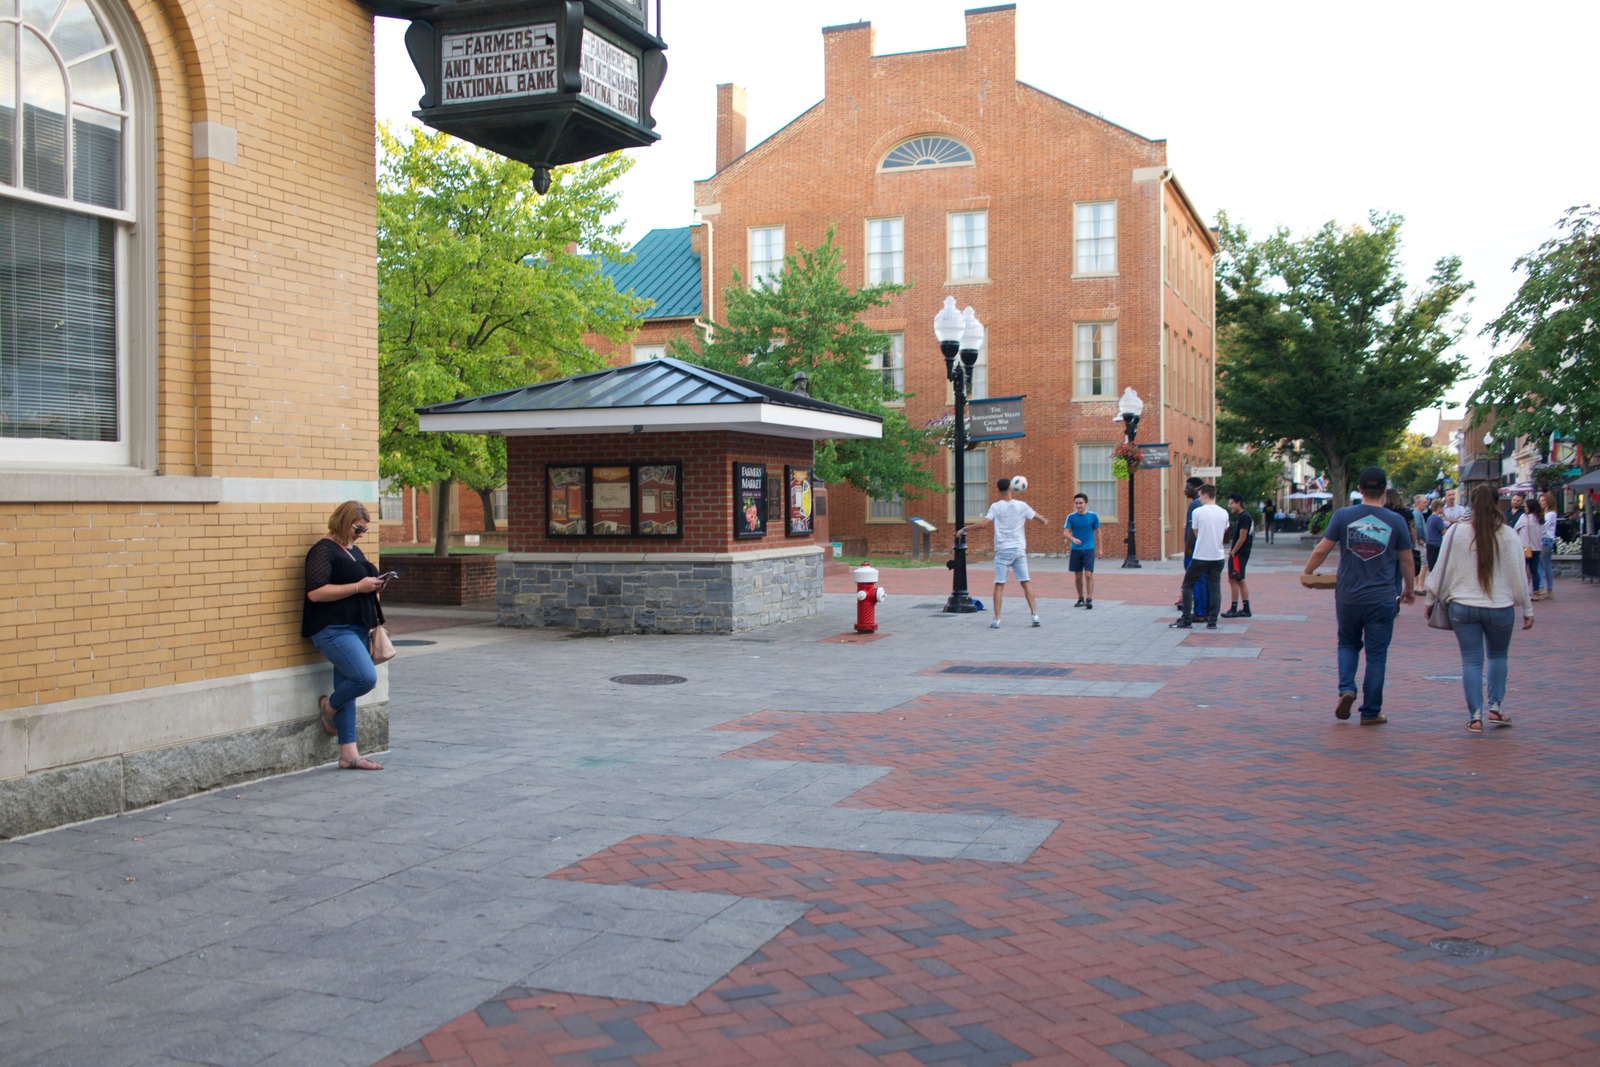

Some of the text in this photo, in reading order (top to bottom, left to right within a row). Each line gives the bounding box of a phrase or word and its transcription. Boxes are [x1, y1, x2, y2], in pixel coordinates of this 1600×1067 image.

[465, 30, 533, 55] FARMERS
[444, 49, 555, 79] AND MERCHANTS
[446, 70, 555, 100] NATIONAL BANK
[617, 94, 638, 119] BANK
[741, 466, 762, 477] FARMERS
[741, 478, 762, 489] MARKET
